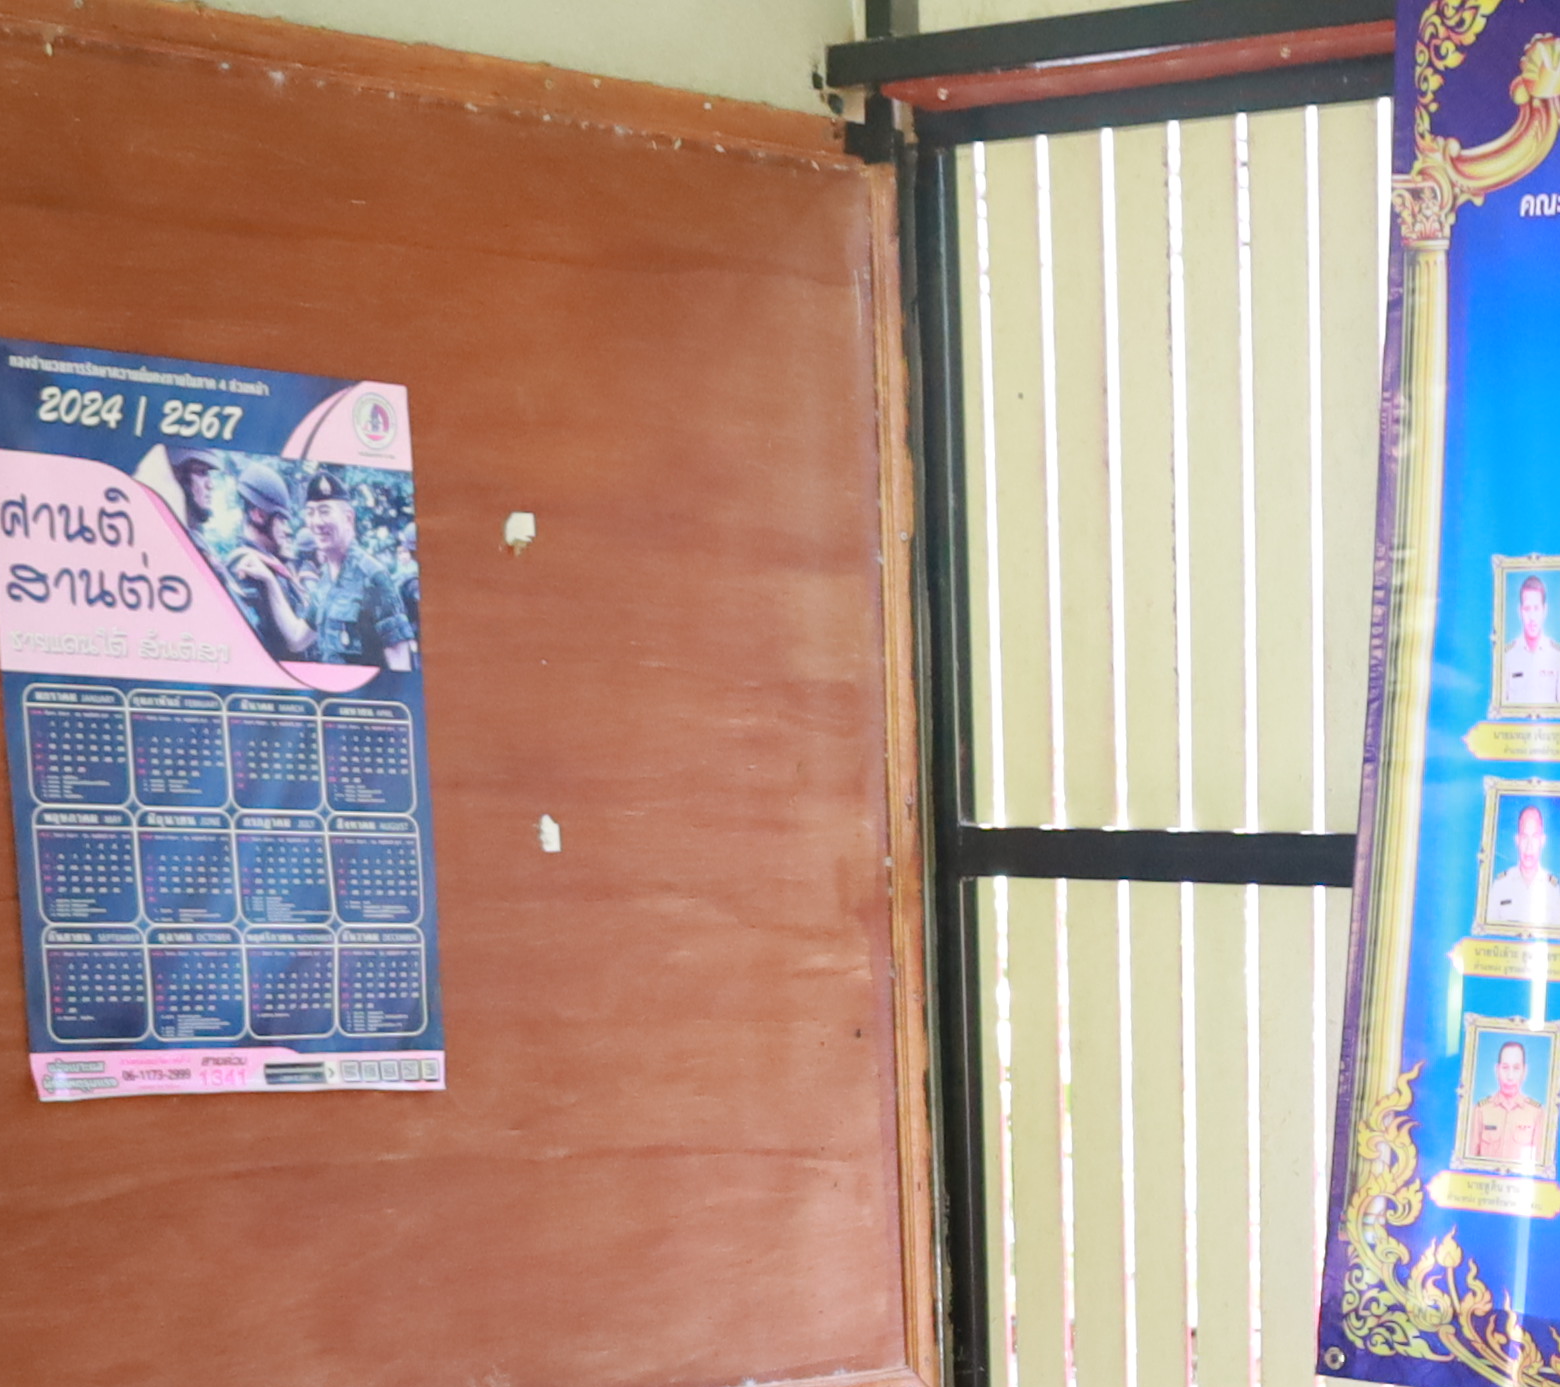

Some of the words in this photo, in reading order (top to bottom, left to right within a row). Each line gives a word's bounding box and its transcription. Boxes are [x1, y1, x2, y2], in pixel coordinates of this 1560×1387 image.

[39, 386, 125, 429] 2024
[160, 400, 243, 441] 2567
[6, 551, 192, 613] สานต่อ
[199, 1069, 248, 1087] 1341
